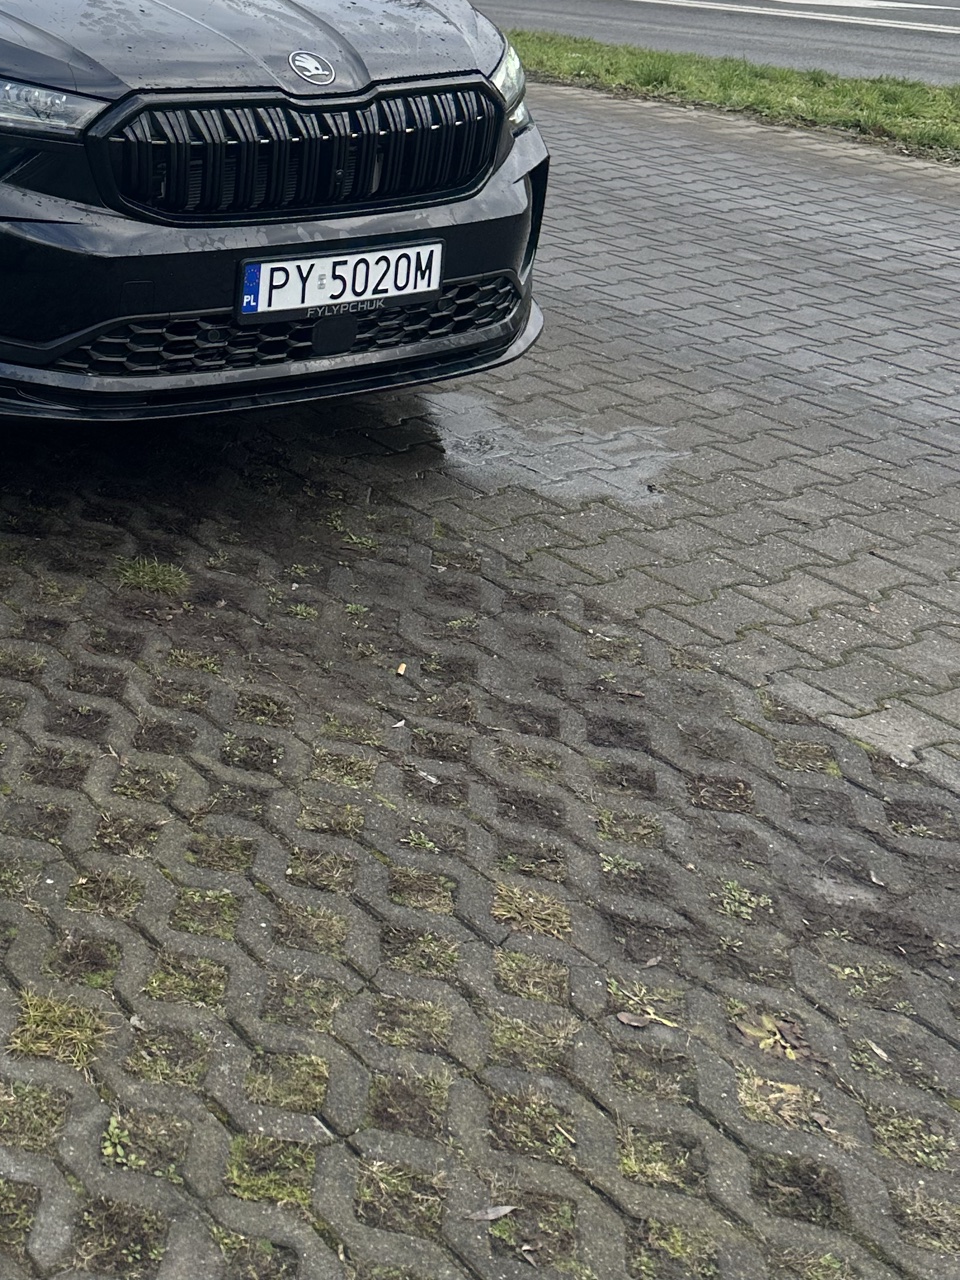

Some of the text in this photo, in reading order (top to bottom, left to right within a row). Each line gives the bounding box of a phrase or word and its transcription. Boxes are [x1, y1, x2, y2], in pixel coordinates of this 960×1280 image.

[267, 250, 434, 308] PY 5020M
[242, 294, 257, 307] PL
[306, 298, 386, 318] FYLYPCHUK
